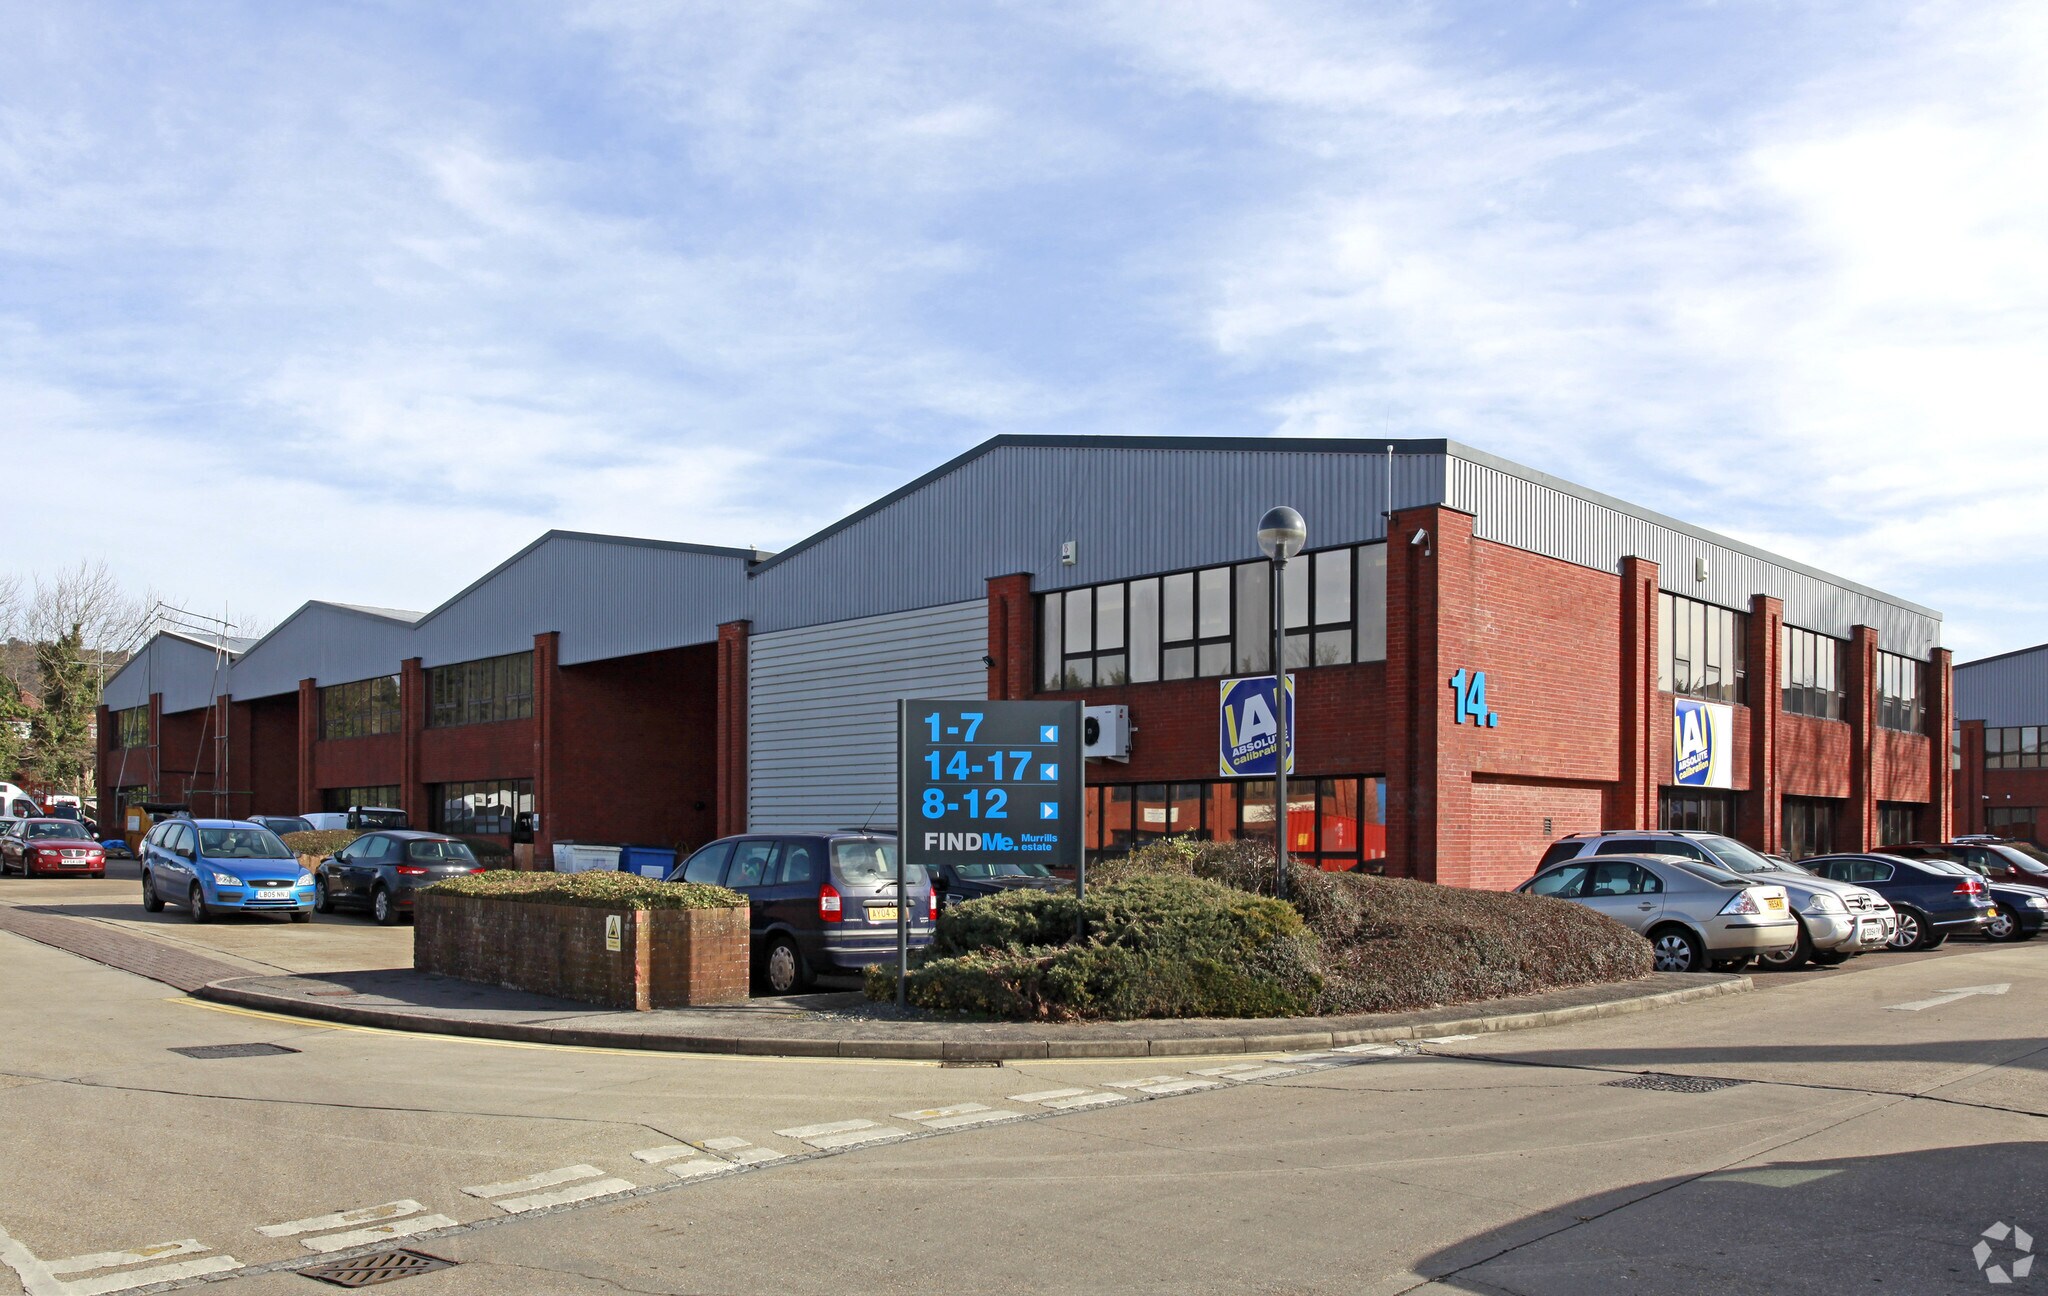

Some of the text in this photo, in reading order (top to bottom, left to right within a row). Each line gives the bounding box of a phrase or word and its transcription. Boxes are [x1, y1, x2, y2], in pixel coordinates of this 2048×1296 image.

[1451, 668, 1498, 727] 14.
[924, 712, 984, 742] 1-7
[1232, 730, 1289, 758] ABSOLU
[1233, 740, 1291, 766] calibratin
[924, 750, 1033, 781] 14-17
[1678, 749, 1709, 771] ABSOLUTE
[1679, 760, 1709, 780] calibration
[921, 788, 1008, 819] 8-12
[1021, 833, 1058, 842] Murrills
[1021, 843, 1053, 851] estate
